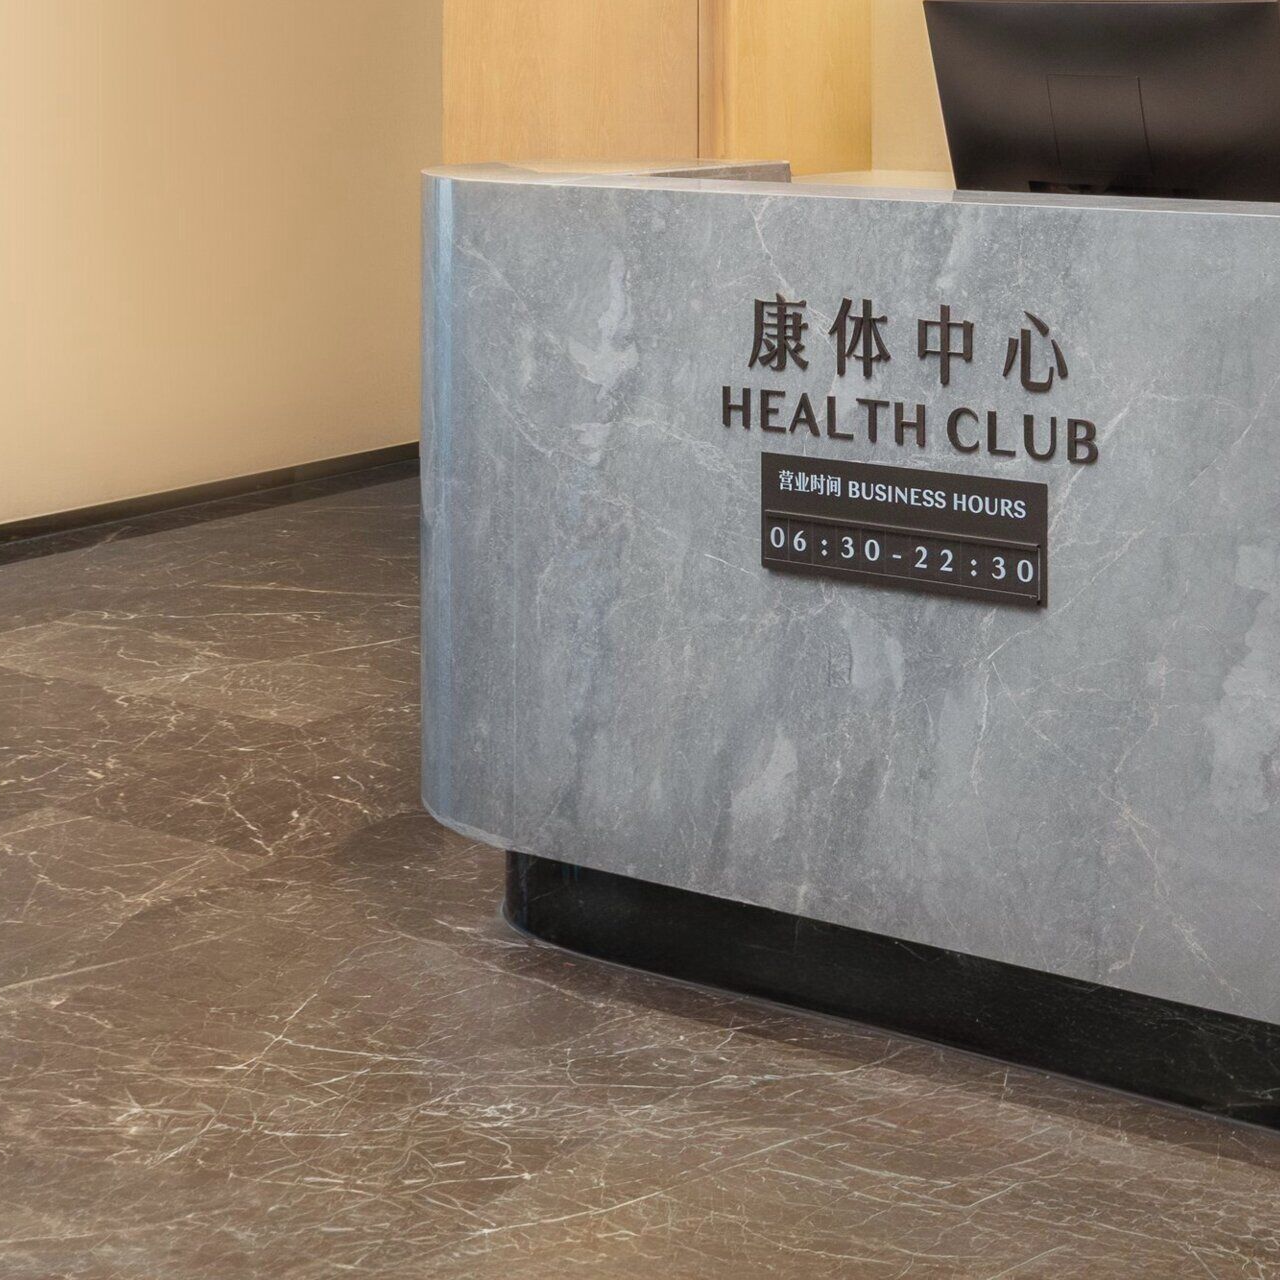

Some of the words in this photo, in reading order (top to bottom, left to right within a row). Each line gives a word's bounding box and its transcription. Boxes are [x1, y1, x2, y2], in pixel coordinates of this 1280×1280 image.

[748, 293, 1068, 392] 康体中心
[722, 385, 927, 447] HEALTH
[946, 407, 1099, 464] CLUB
[778, 470, 841, 497] 营业时间
[848, 481, 946, 508] BUSINESS
[953, 493, 1026, 518] HOURS
